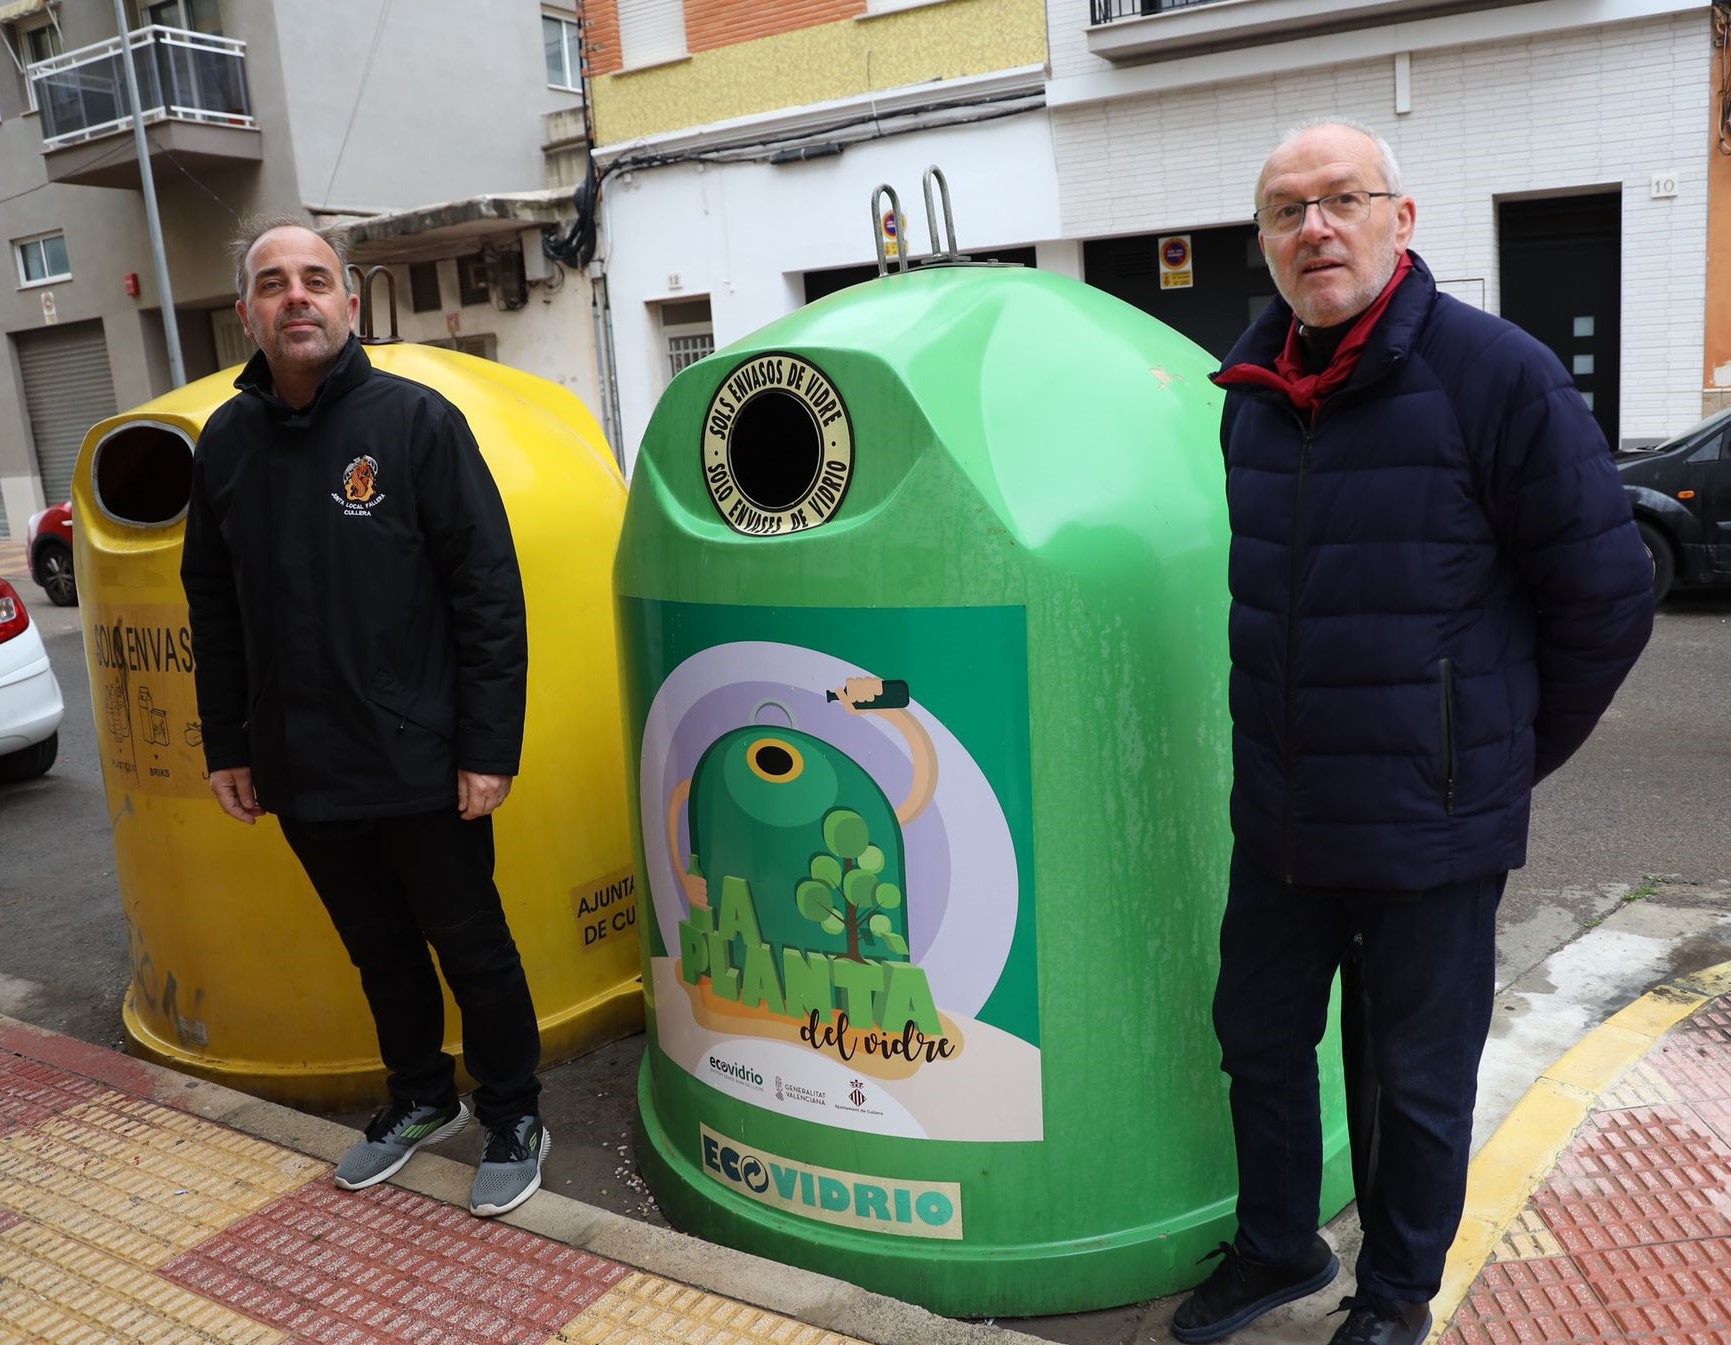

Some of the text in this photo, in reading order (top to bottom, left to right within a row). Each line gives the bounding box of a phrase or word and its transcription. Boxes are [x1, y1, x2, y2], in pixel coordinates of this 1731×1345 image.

[1655, 179, 1675, 193] 10
[709, 359, 842, 441] SOLS ENVASOS DE VIDRE
[365, 493, 386, 508] FALLERA
[728, 498, 783, 534] ENVASES
[790, 508, 809, 531] DE
[807, 460, 848, 519] VIDRIO
[149, 767, 170, 778] BRIKS
[584, 919, 607, 946] DE
[678, 920, 944, 1036] PLANTA
[799, 1008, 956, 1064] del vidre
[709, 1056, 763, 1086] ecovidrio
[784, 1083, 827, 1099] GENERALITAT
[785, 1091, 826, 1106] VALENCIANA
[703, 1134, 954, 1227] ECOVIDRIO
